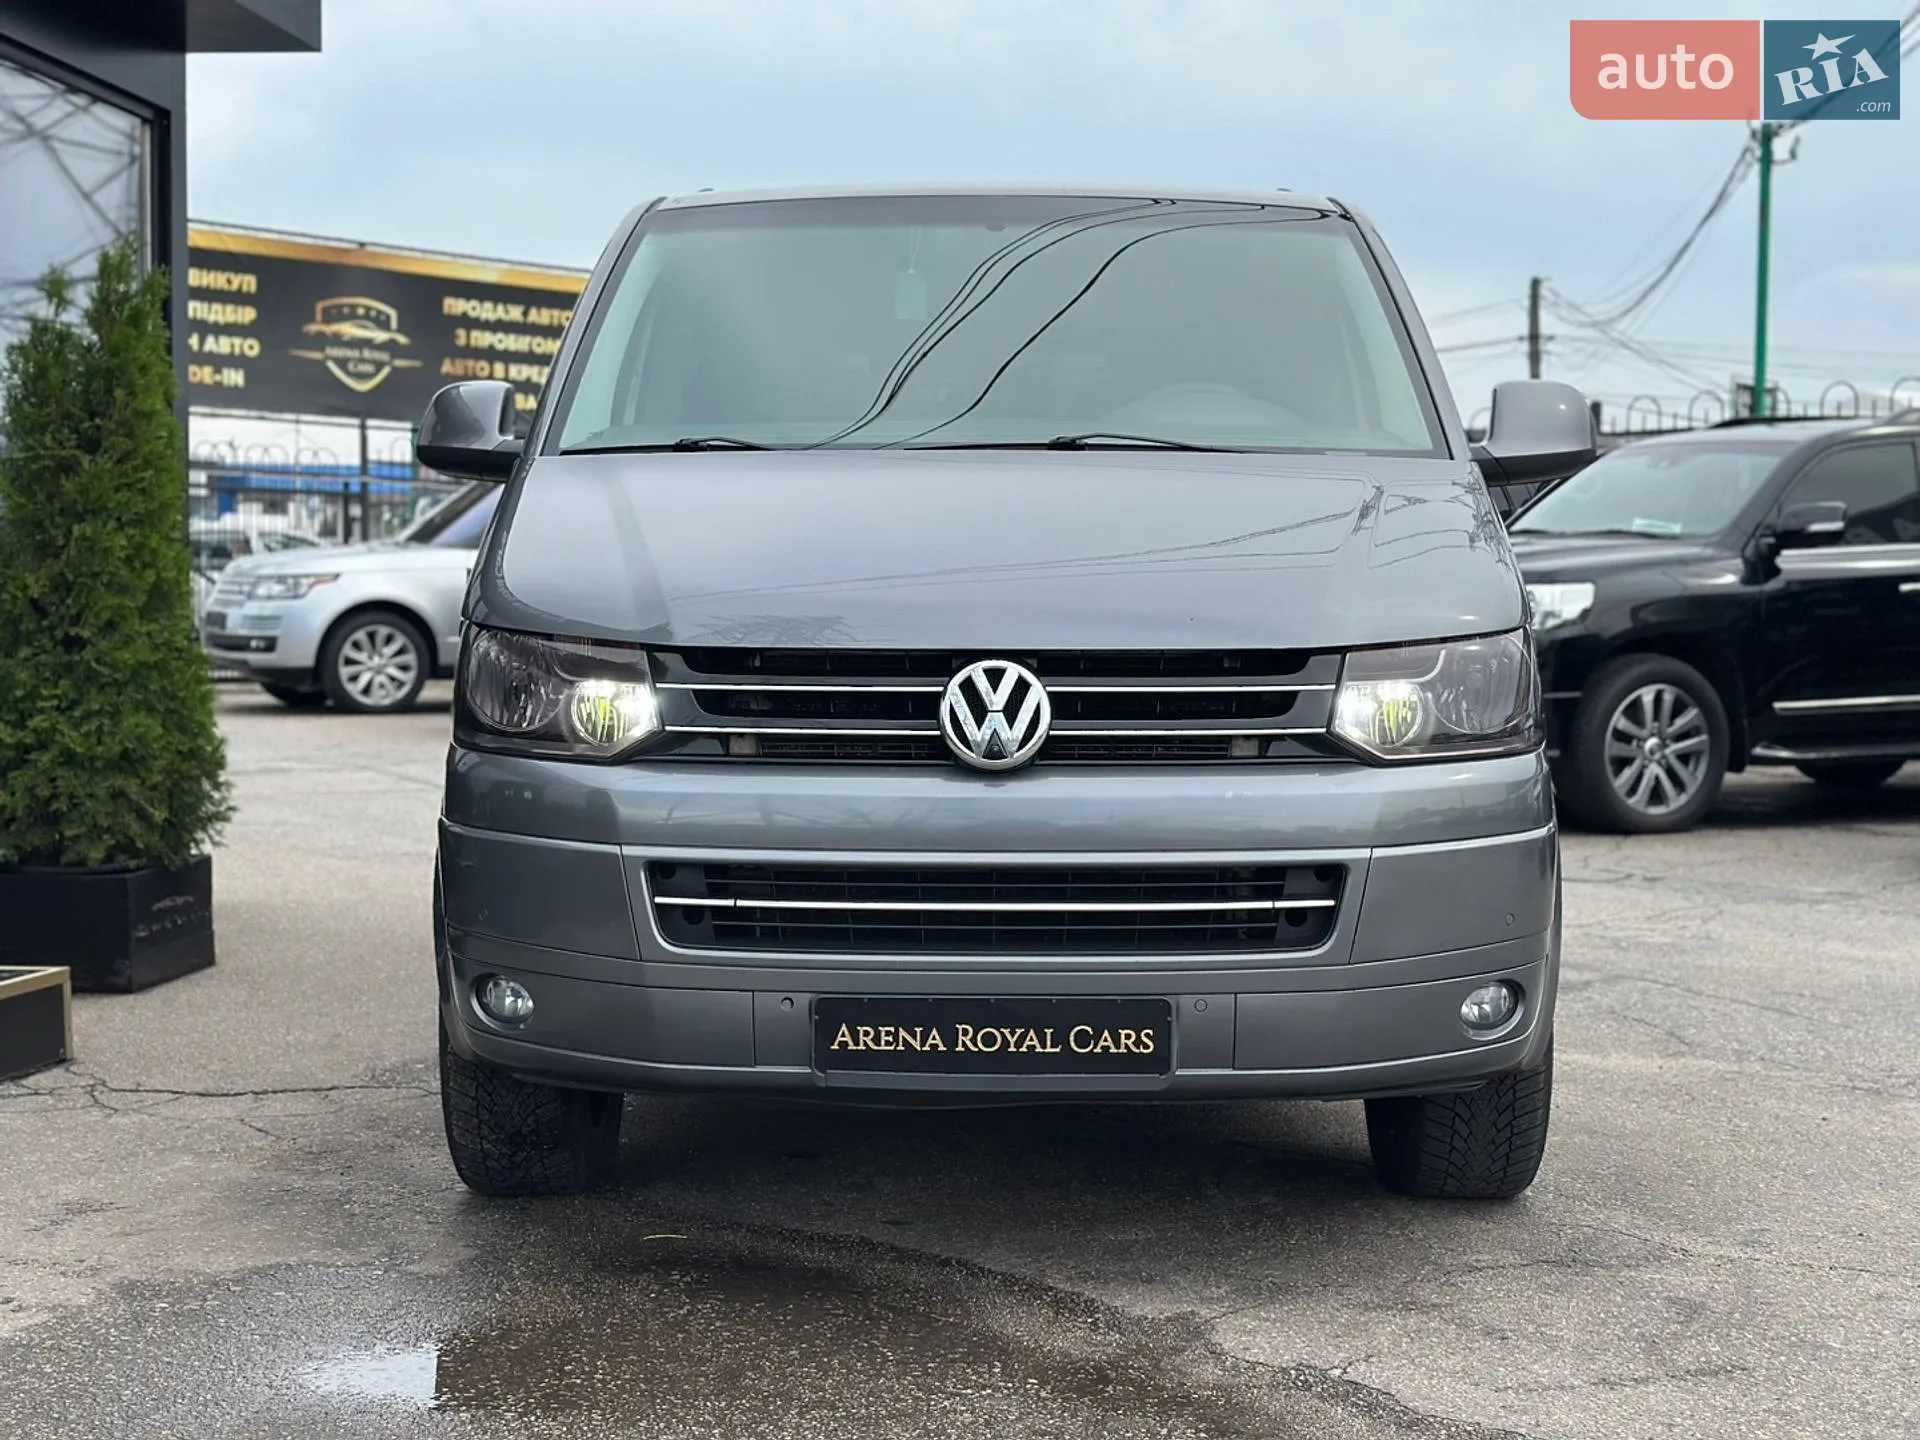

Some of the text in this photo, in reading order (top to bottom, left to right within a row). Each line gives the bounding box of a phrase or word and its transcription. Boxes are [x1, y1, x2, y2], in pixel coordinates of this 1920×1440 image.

[187, 266, 257, 294] ВИКУП
[187, 299, 257, 325] ПІДБІР
[443, 296, 573, 327] ПРОДАЖ АВТО
[202, 333, 261, 358] АВТО
[441, 357, 491, 379] АВТО
[493, 361, 506, 380] В
[830, 1023, 1155, 1054] ARENA ROYAL CARS
